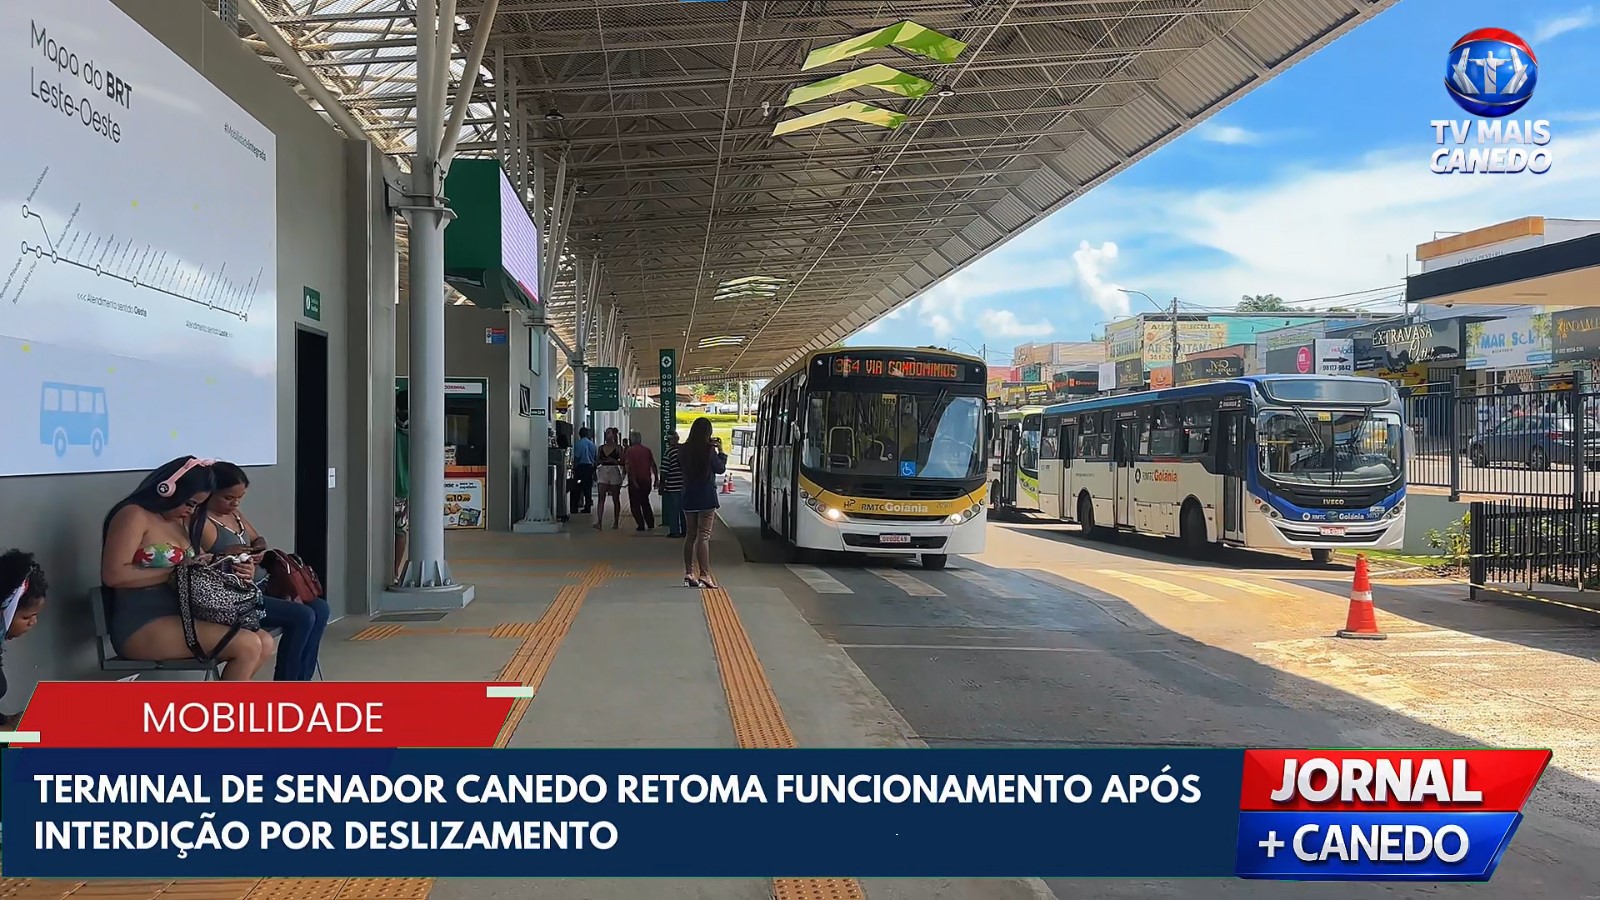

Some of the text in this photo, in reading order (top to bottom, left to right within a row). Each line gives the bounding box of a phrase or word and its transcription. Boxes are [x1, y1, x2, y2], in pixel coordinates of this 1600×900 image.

[31, 19, 132, 110] Mapa do BRT
[31, 66, 121, 143] Leste-Oeste
[1372, 324, 1433, 346] EXTRAVASA
[1480, 334, 1505, 349] MAR
[1165, 342, 1214, 354] SNTANA
[865, 359, 883, 374] VIA
[887, 360, 959, 377] CONDOMINIOS
[861, 503, 885, 511] RMTC
